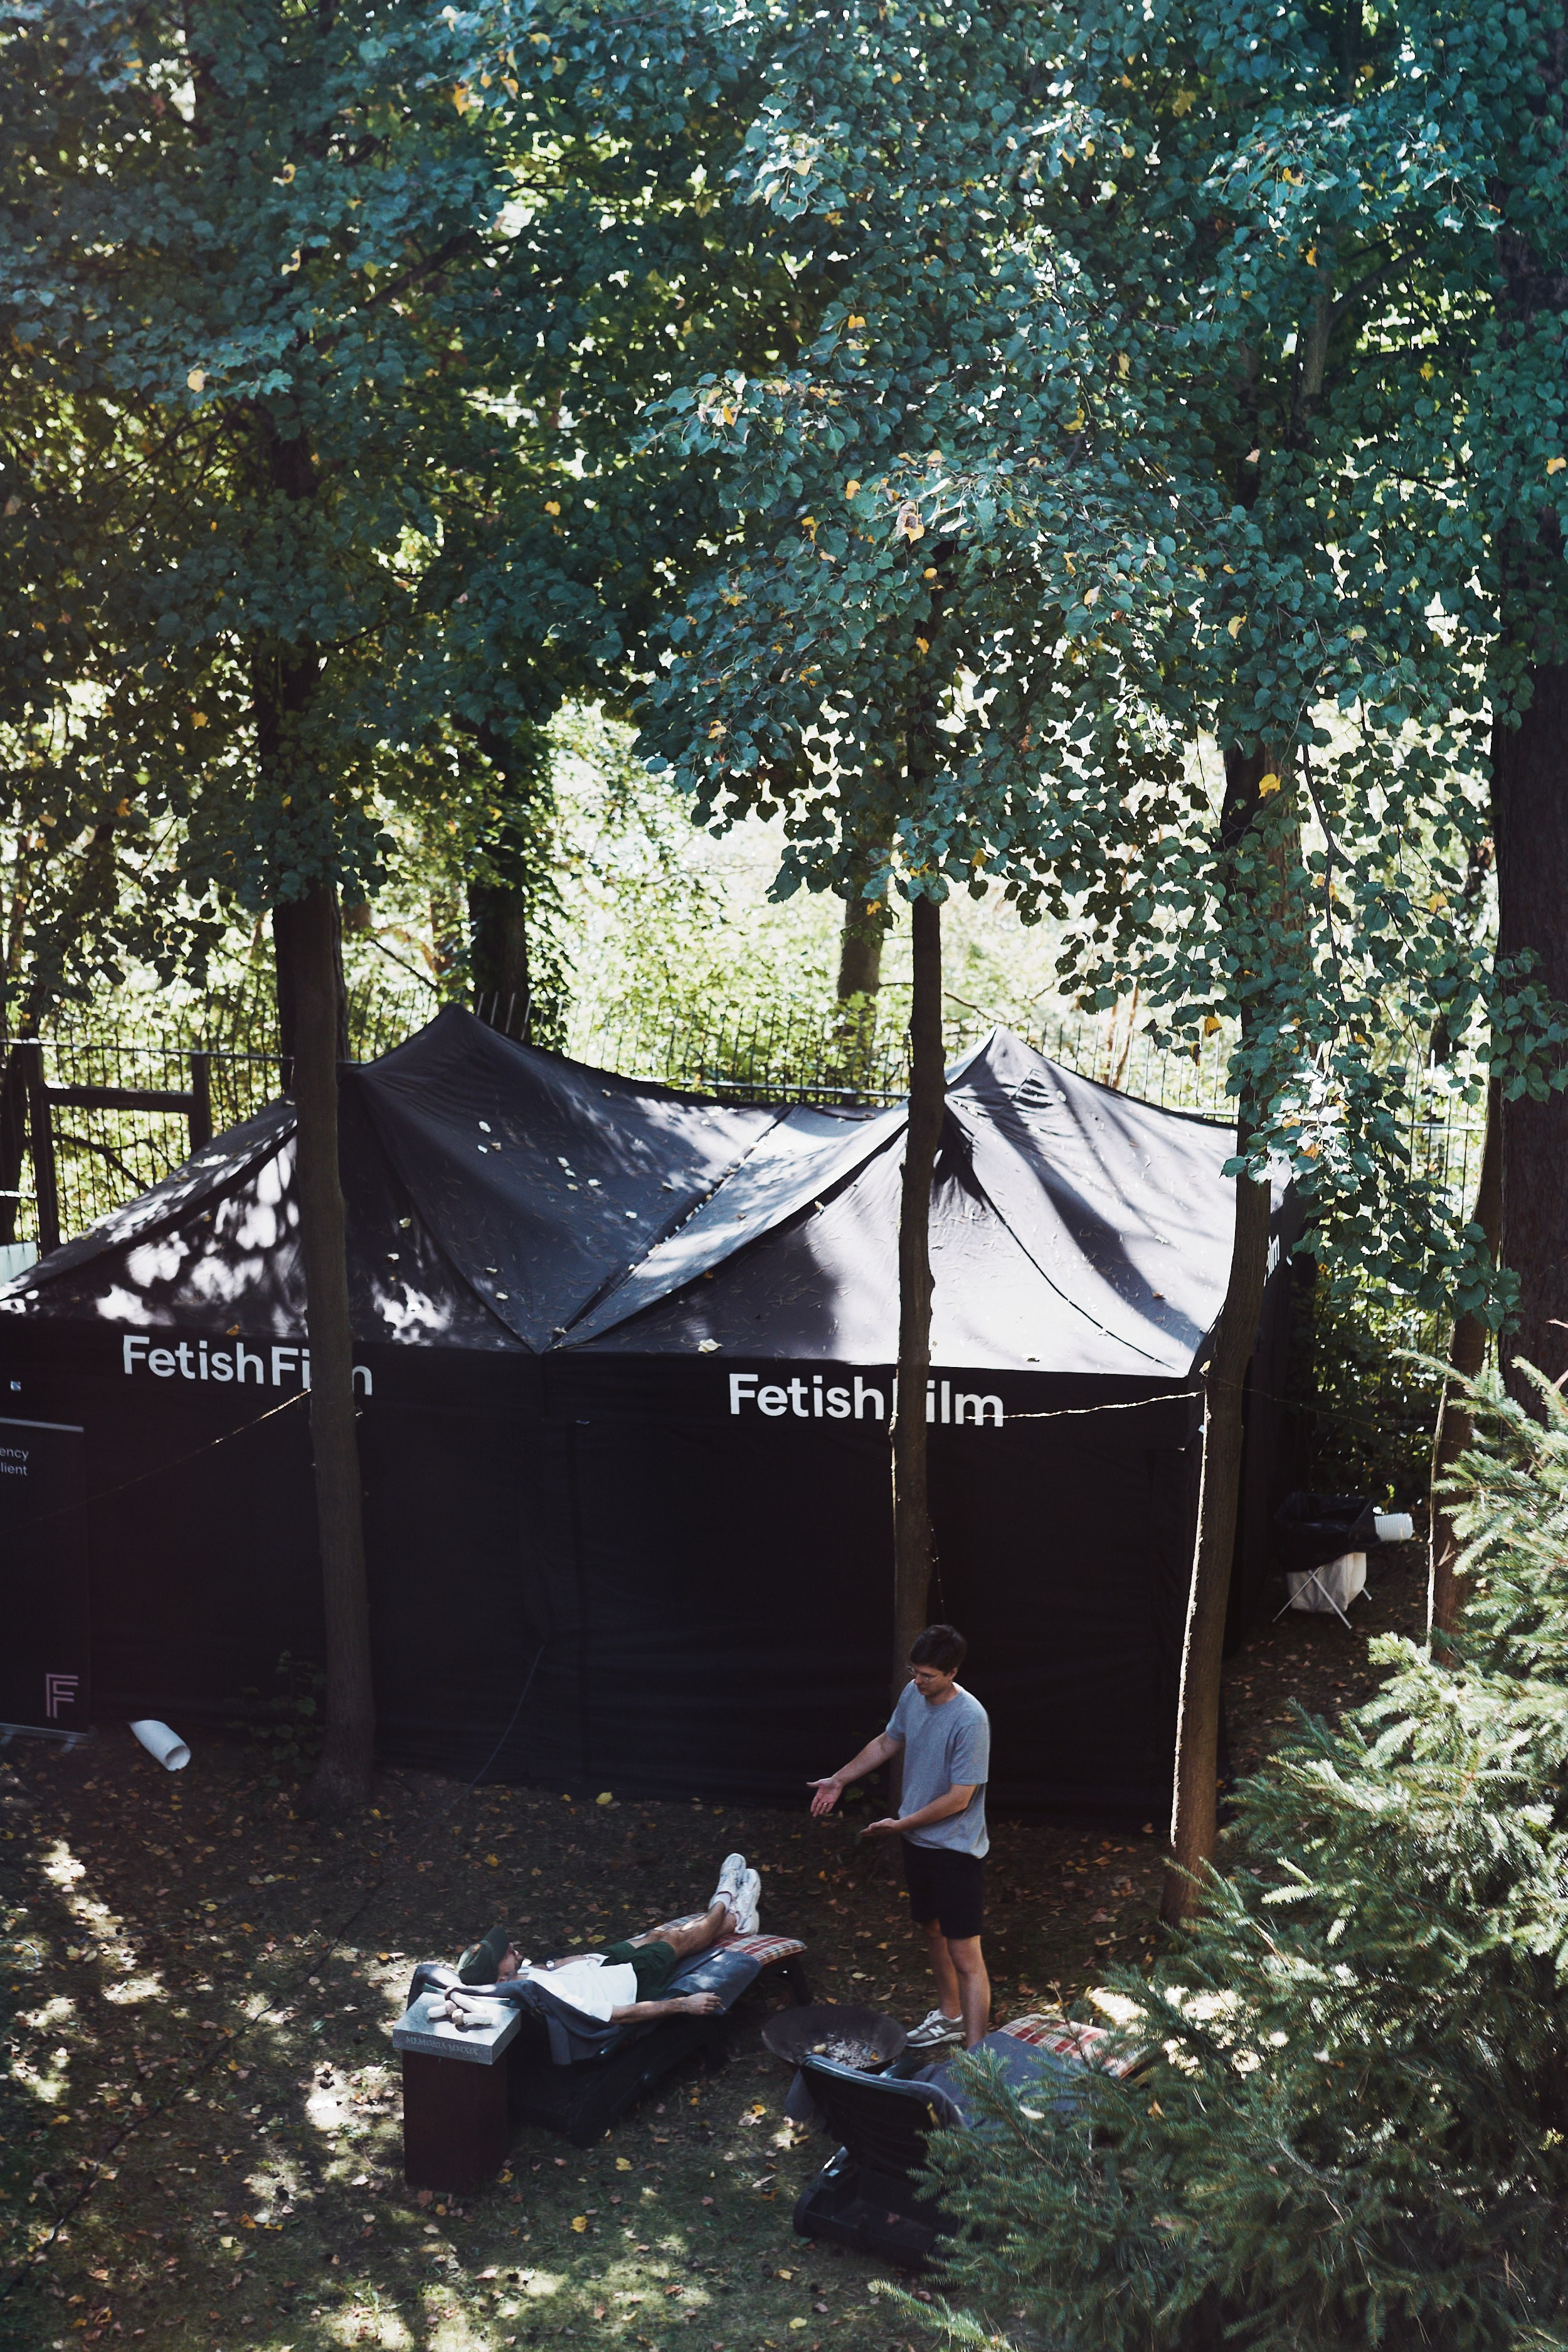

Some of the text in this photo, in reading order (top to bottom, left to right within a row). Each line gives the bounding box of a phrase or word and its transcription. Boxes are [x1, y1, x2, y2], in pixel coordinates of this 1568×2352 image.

[123, 1334, 373, 1396] FetishFi
[729, 1373, 1004, 1427] Fetishilm
[0, 1447, 29, 1462] ency
[0, 1461, 28, 1476] lient
[46, 1673, 78, 1718] F
[929, 2025, 946, 2037] N
